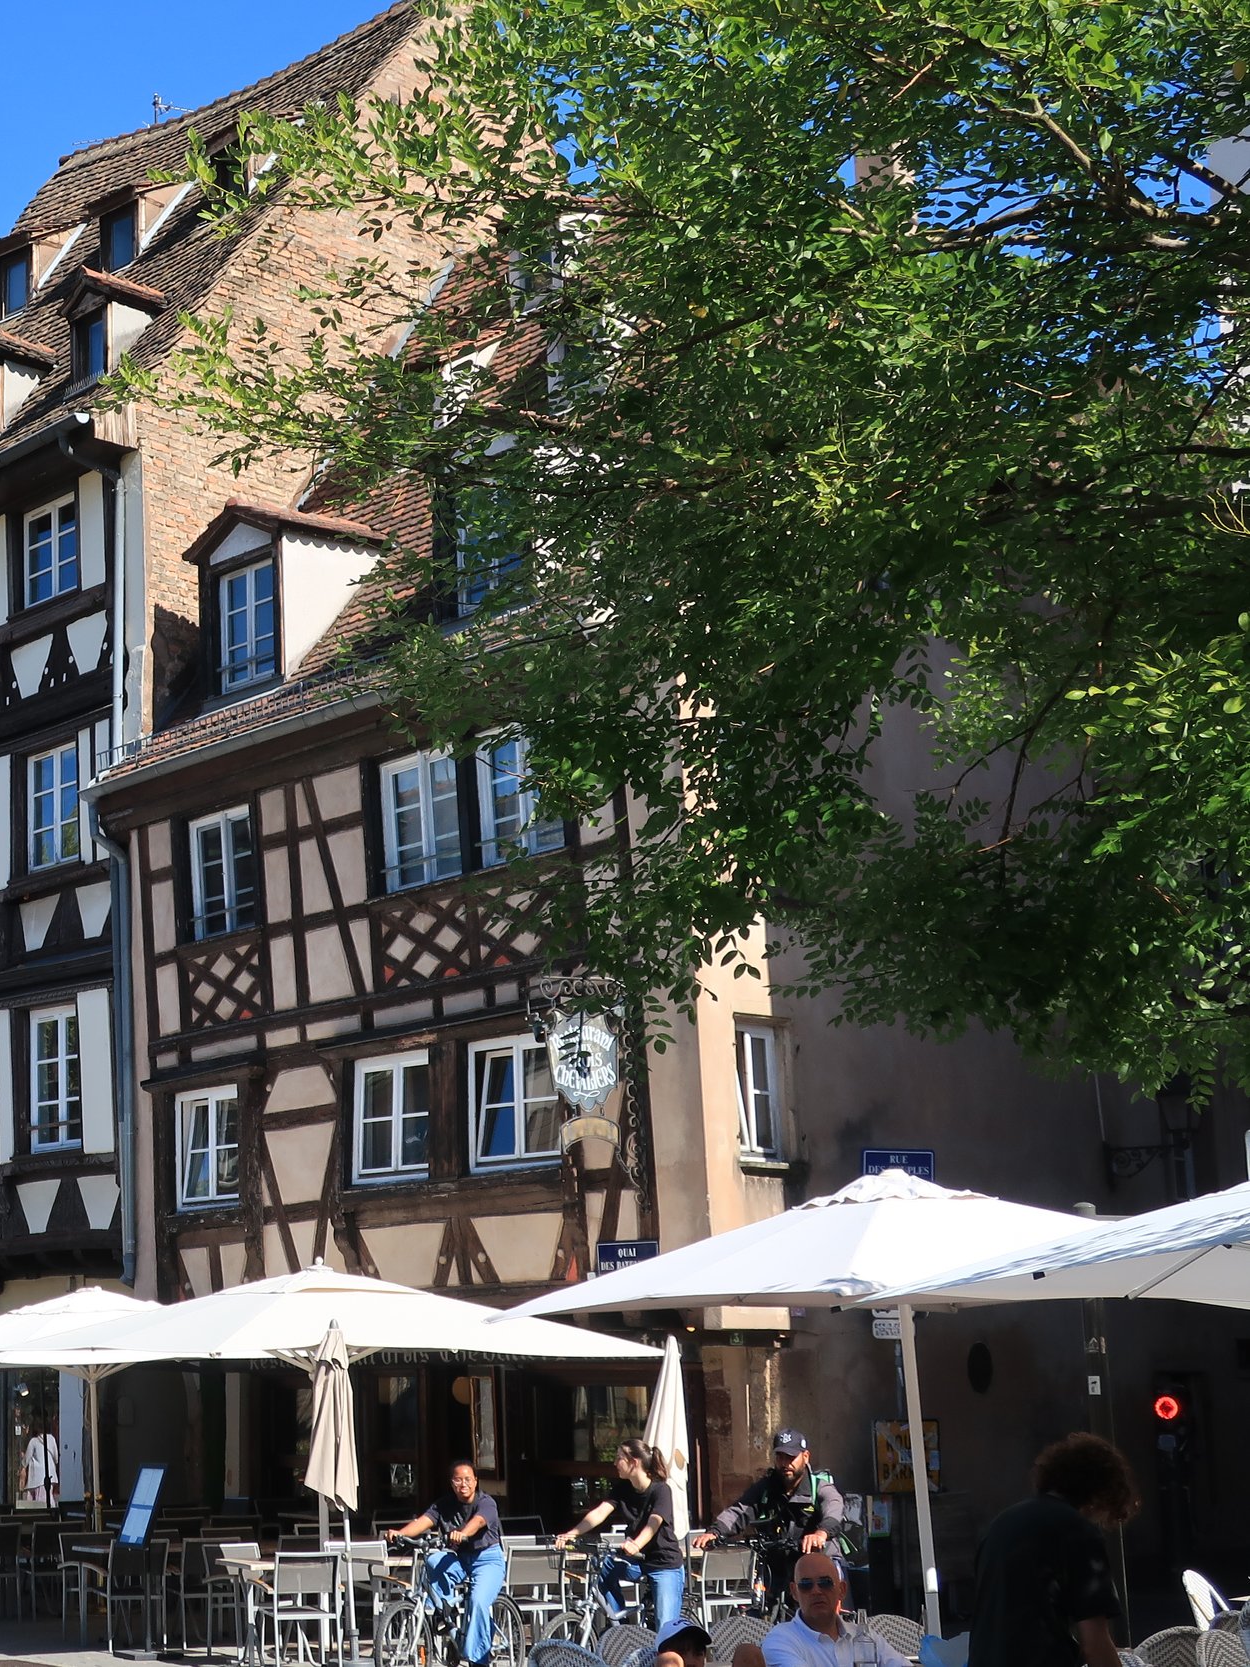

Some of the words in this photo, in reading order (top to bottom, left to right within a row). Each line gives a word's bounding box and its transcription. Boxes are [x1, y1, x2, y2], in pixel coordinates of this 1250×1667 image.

[889, 1155, 909, 1164] RUE
[868, 1165, 886, 1174] DES
[617, 1247, 637, 1258] QUAI
[600, 1261, 615, 1271] DES
